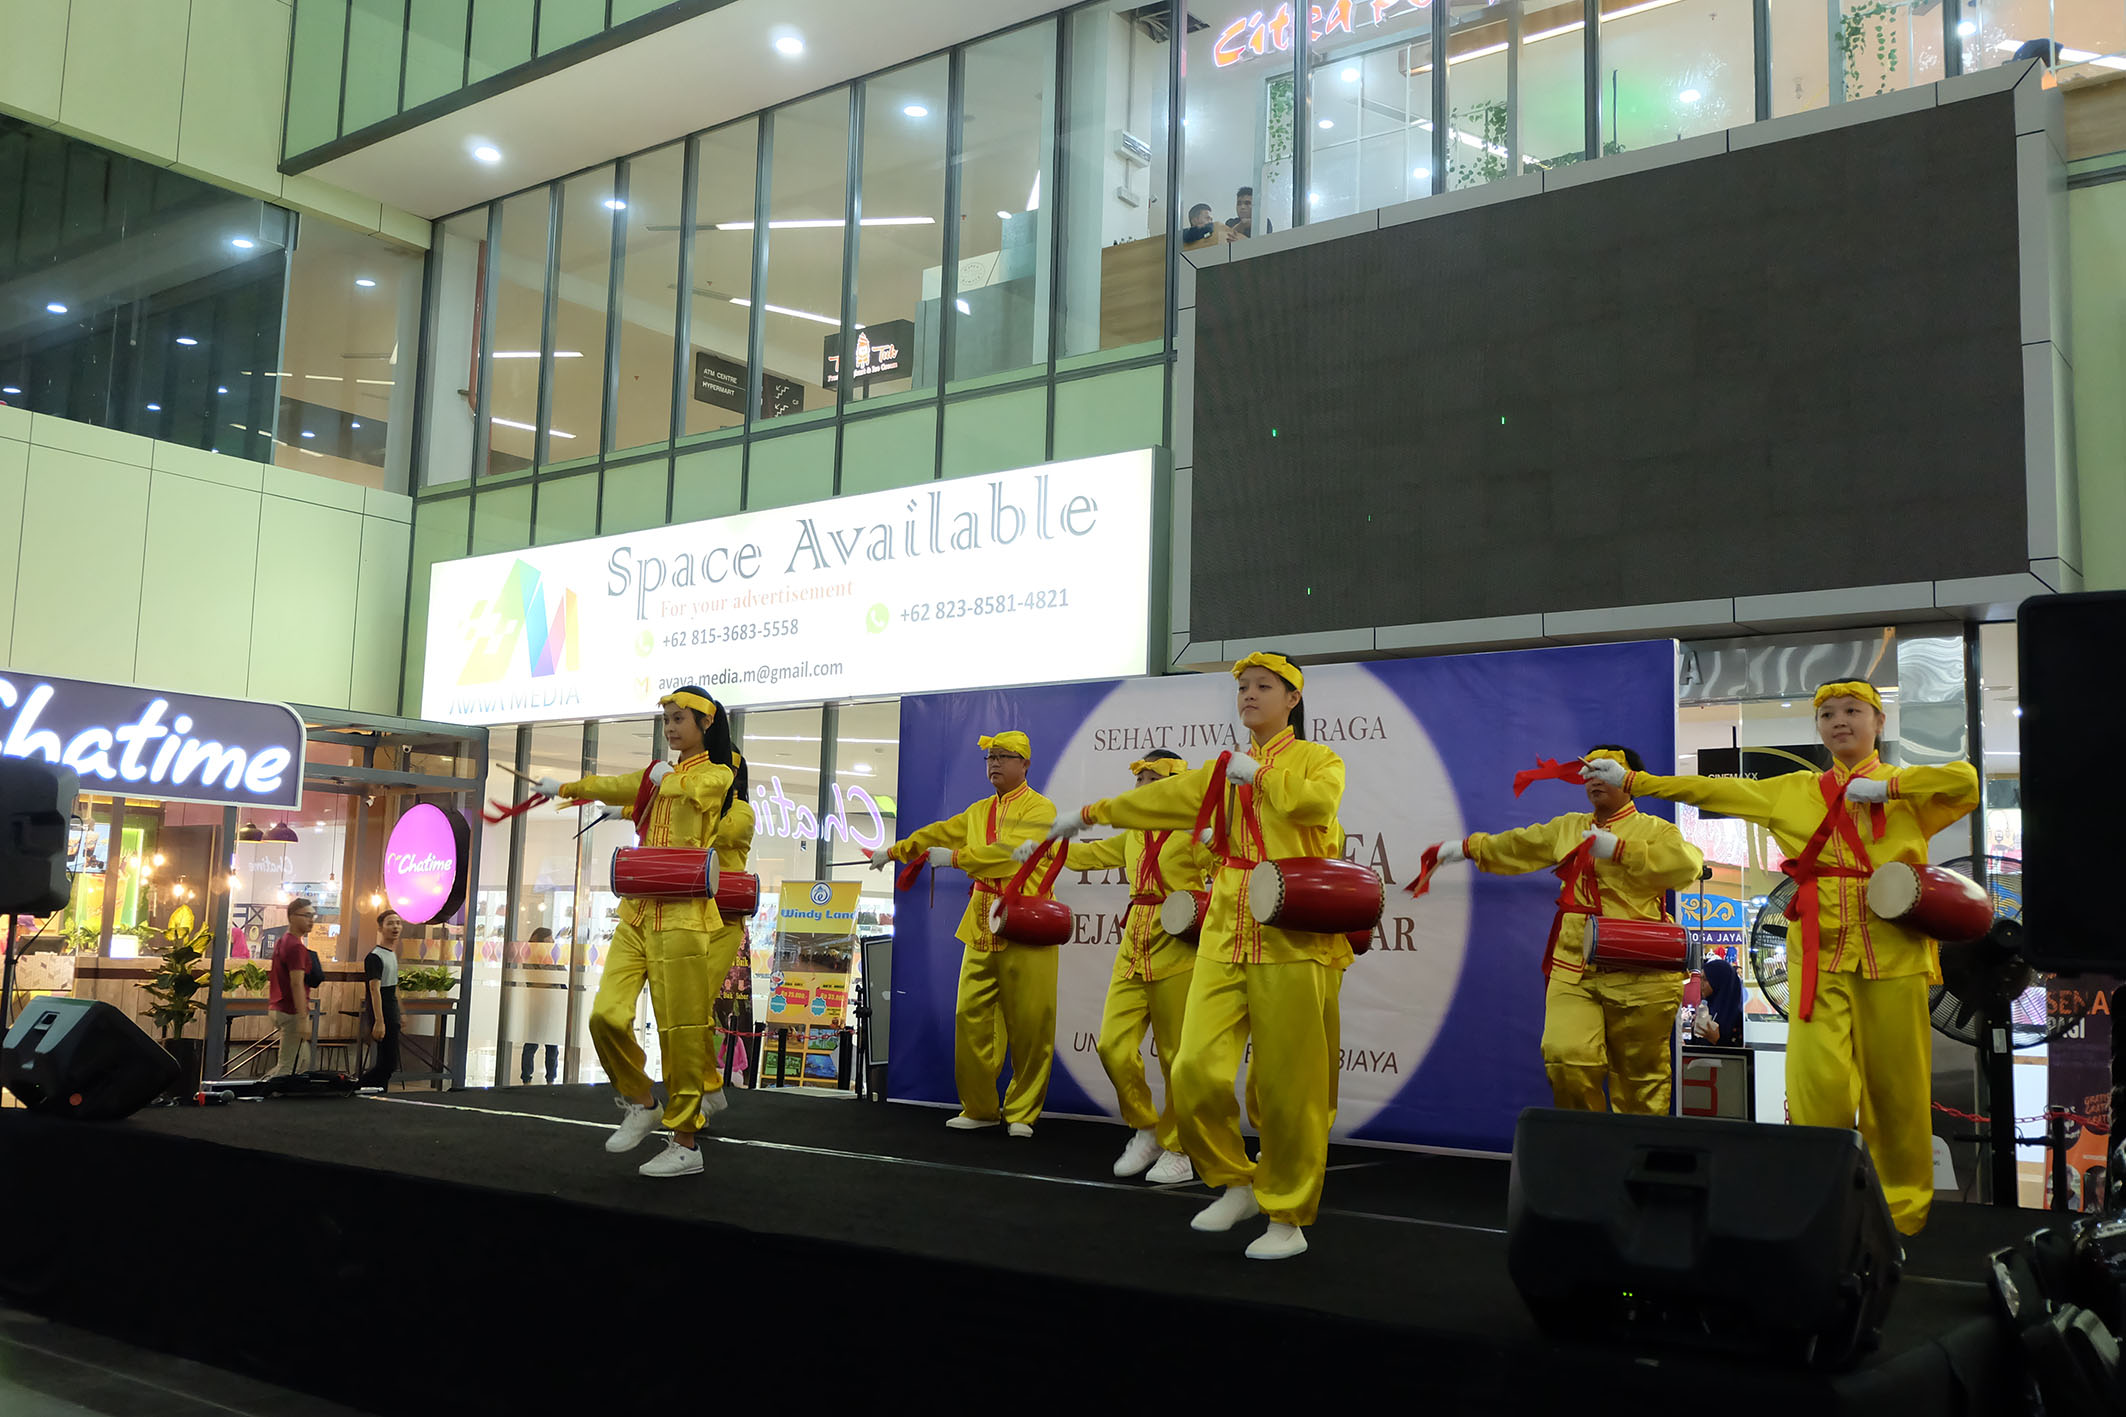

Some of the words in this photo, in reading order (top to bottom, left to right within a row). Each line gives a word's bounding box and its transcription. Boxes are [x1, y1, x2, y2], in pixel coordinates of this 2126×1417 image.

[702, 381, 735, 396] HYPERMART
[703, 368, 715, 377] ATM
[716, 372, 738, 384] CENTRE
[607, 543, 763, 621] Space
[784, 474, 1099, 575] Available
[661, 600, 687, 618] For
[693, 597, 728, 620] your
[733, 581, 853, 609] advertisement
[900, 603, 930, 622] +62
[935, 588, 1069, 620] 823-8581-4821
[663, 631, 687, 648] +62
[691, 618, 799, 645] 815-3683-5558
[1094, 725, 1173, 751] SEHAT
[1178, 723, 1240, 748] JIWA
[1312, 715, 1388, 743] RAGA
[398, 852, 453, 875] Chatime
[781, 908, 822, 922] Windy
[1716, 932, 1742, 942] JAYA
